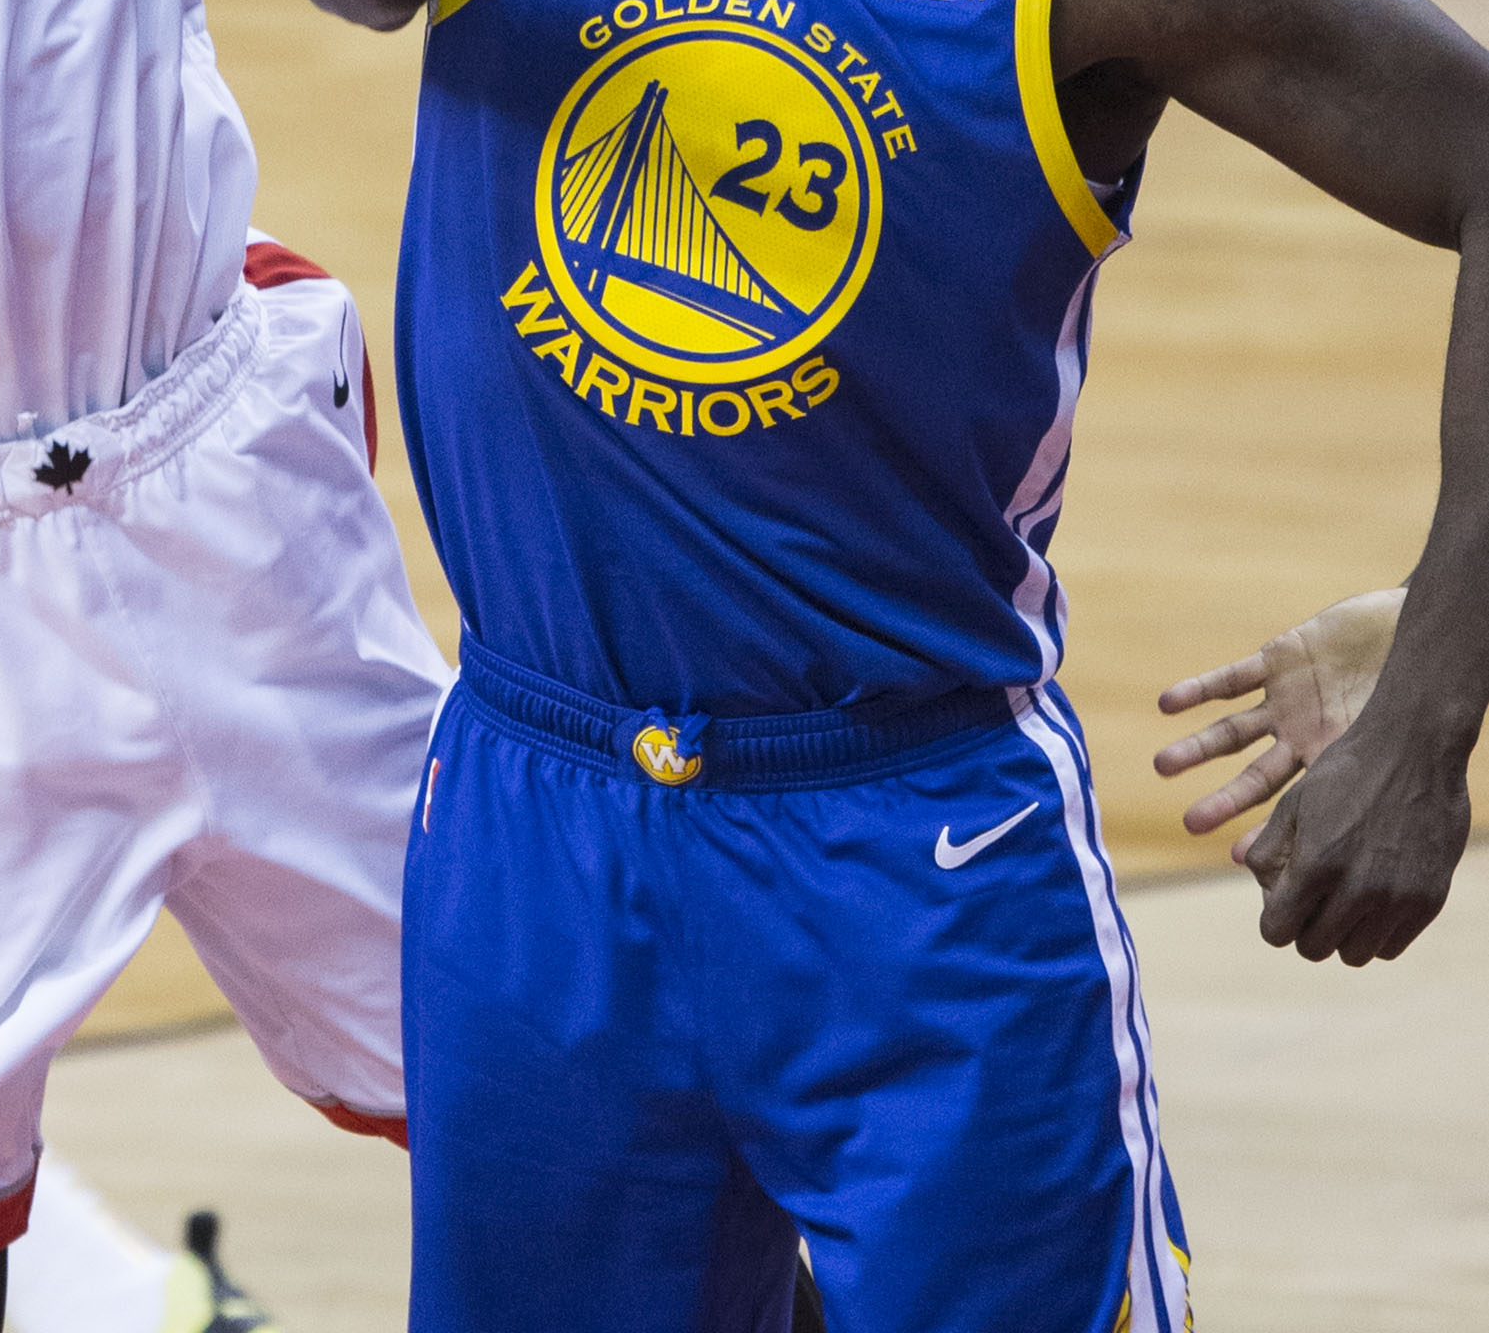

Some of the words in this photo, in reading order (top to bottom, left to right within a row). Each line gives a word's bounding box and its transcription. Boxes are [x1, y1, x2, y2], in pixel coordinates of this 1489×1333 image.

[803, 22, 919, 162] STATE
[710, 118, 849, 232] 23
[499, 259, 841, 438] WARRIORS
